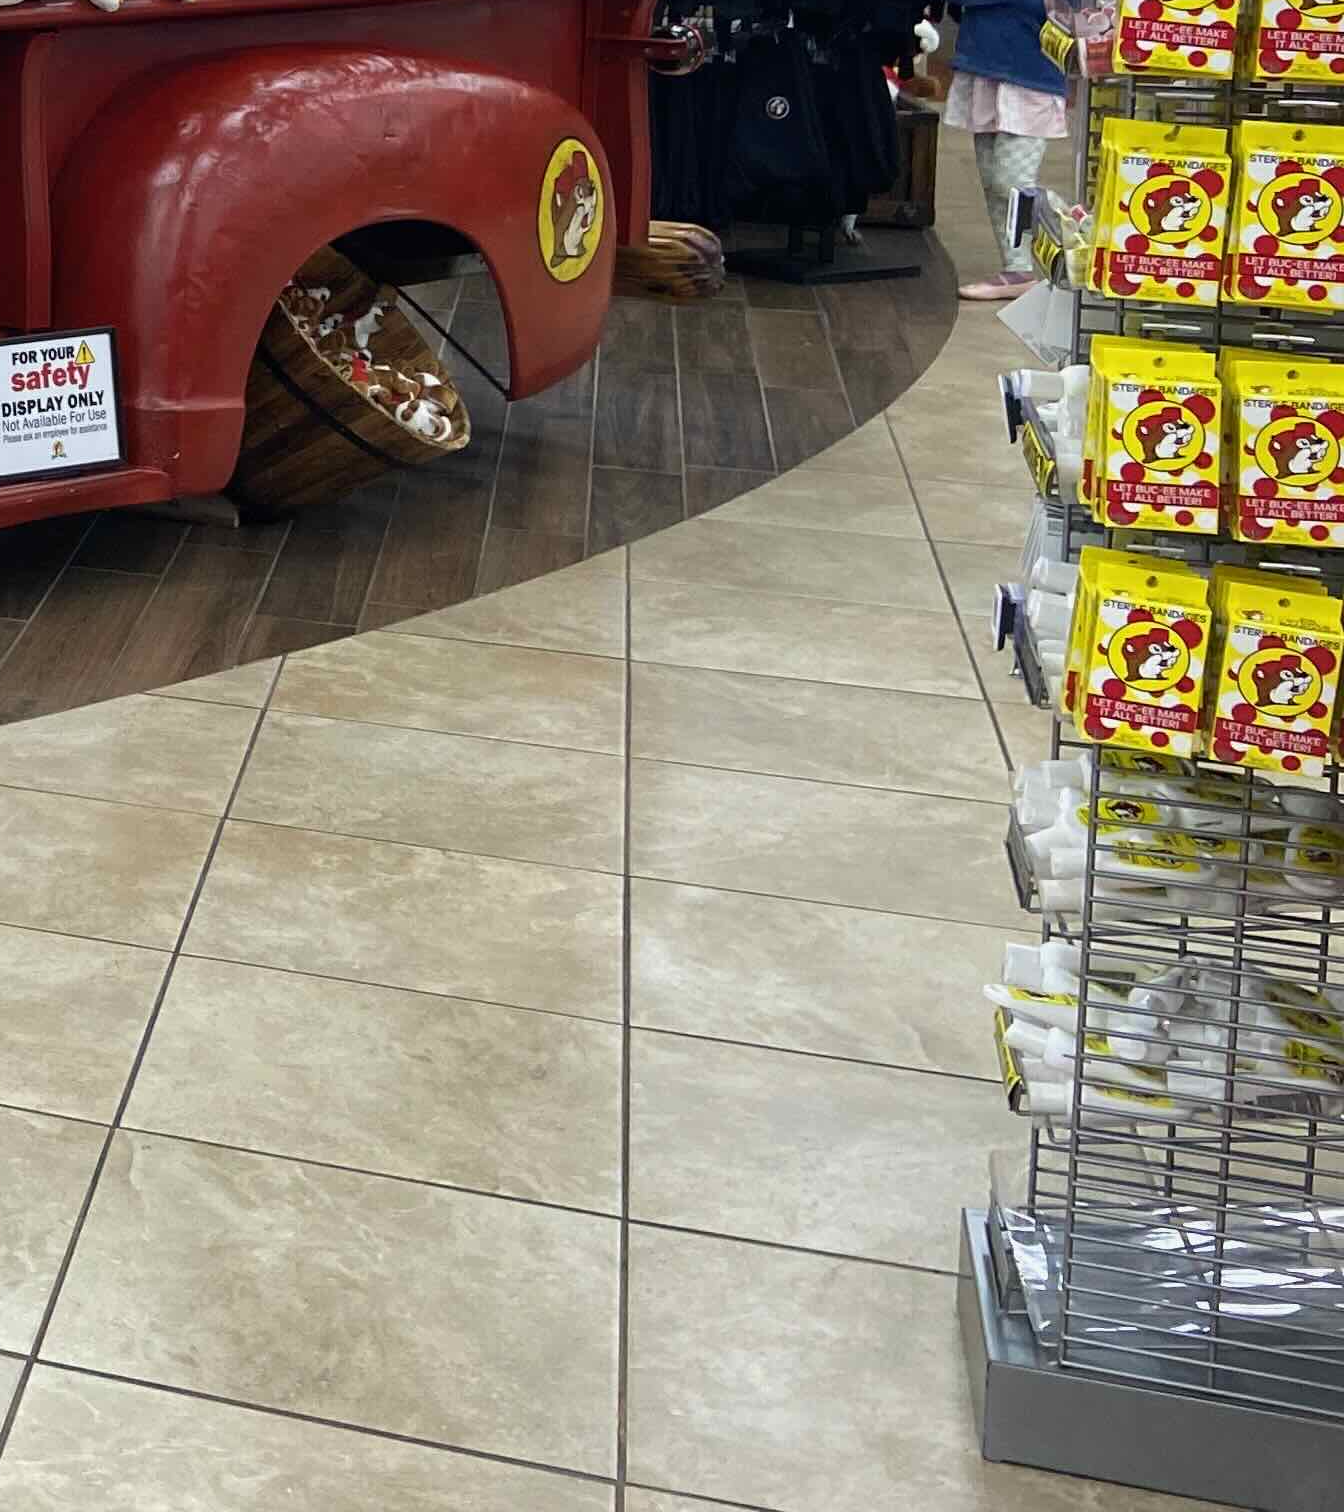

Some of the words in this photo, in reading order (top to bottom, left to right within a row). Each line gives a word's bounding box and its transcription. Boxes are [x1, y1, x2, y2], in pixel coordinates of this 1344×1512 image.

[1128, 20, 1149, 30] LET
[1267, 31, 1288, 40] LET
[1116, 254, 1136, 264] LET
[1245, 256, 1267, 266] LET
[12, 349, 37, 366] FOR
[40, 345, 75, 362] YOUR
[11, 360, 90, 392] safety
[1, 395, 63, 418] DISPLAY
[67, 390, 104, 409] ONLY
[2, 420, 20, 433] Not
[23, 411, 67, 430] Available
[70, 411, 85, 424] For
[88, 408, 106, 421] Use
[1113, 483, 1134, 493] LET
[1246, 499, 1267, 508] LET
[1093, 697, 1113, 709] LET
[1223, 721, 1243, 733] LET
